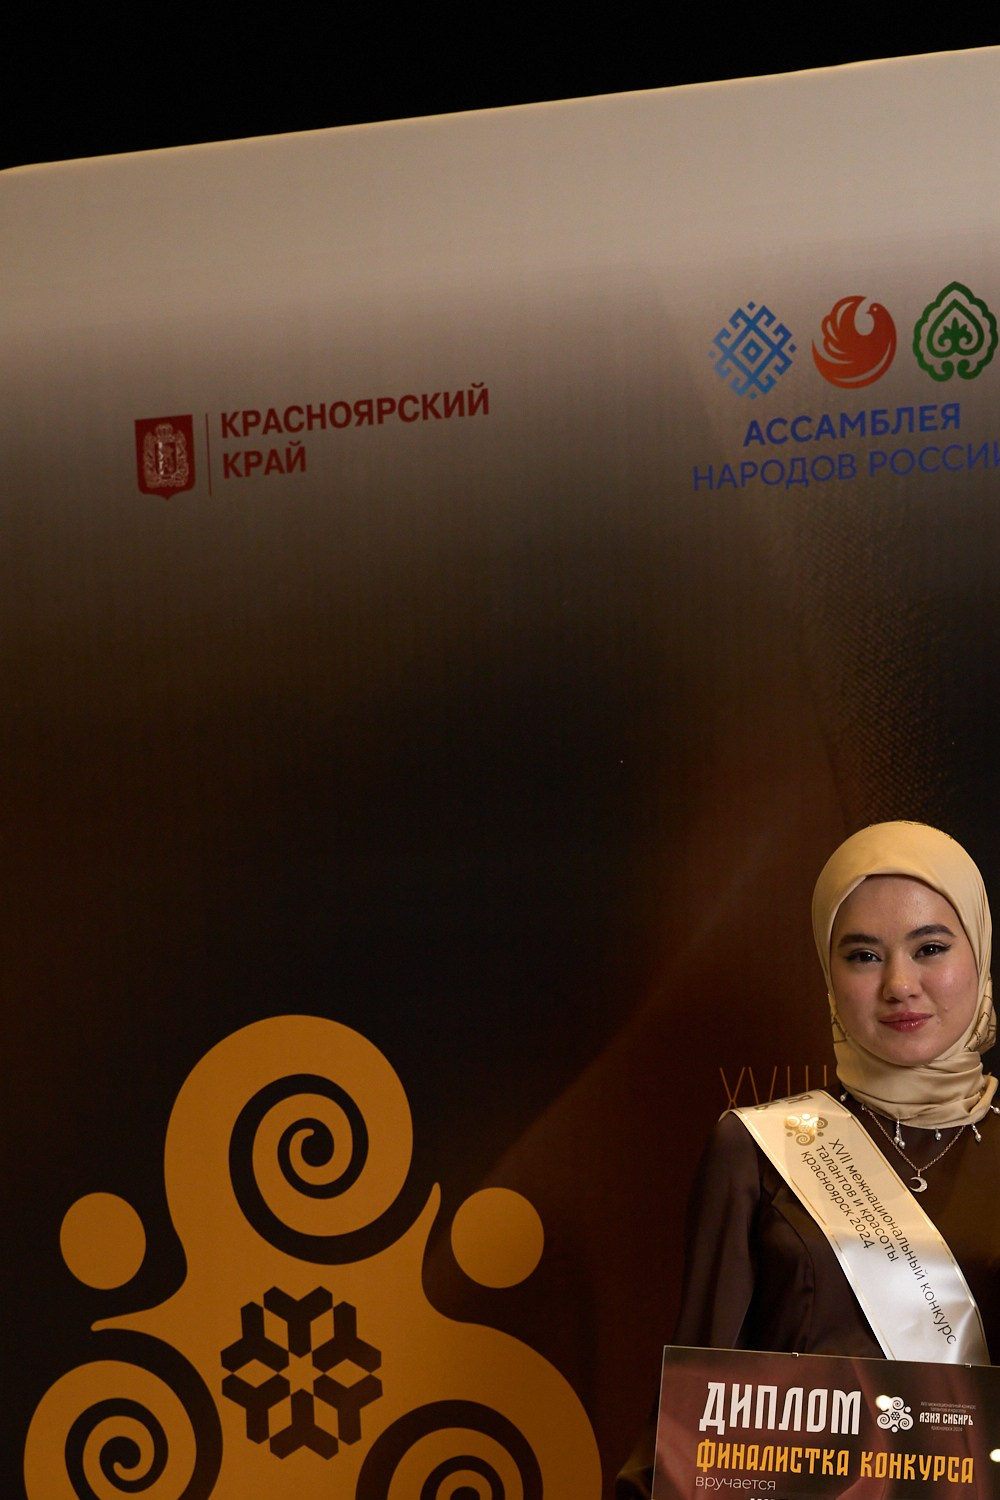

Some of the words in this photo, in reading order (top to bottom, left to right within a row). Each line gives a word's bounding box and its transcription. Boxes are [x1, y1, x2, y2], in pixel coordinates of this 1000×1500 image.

[220, 382, 490, 438] КРАСНОЯРСКИЙ
[743, 403, 961, 447] АССАМБЛЕЯ
[222, 440, 306, 479] КРАЙ
[692, 453, 857, 492] НАРОДОВ
[800, 1150, 854, 1217] красноярск
[849, 1217, 875, 1250] 2024
[815, 1144, 857, 1199] талантов
[852, 1197, 864, 1208] и
[860, 1207, 899, 1262] красоты
[828, 1138, 853, 1164] XVII
[848, 1164, 929, 1281] межнациональный
[919, 1282, 957, 1345] конкурс
[699, 1381, 862, 1435] ДИПЛОМ
[919, 1411, 941, 1424] АЗИЯ
[942, 1413, 974, 1426] СИБИРЬ
[695, 1476, 776, 1491] вручается
[696, 1438, 850, 1477] ФИНАЛИСТКА
[859, 1451, 974, 1484] КОНКУРСА
